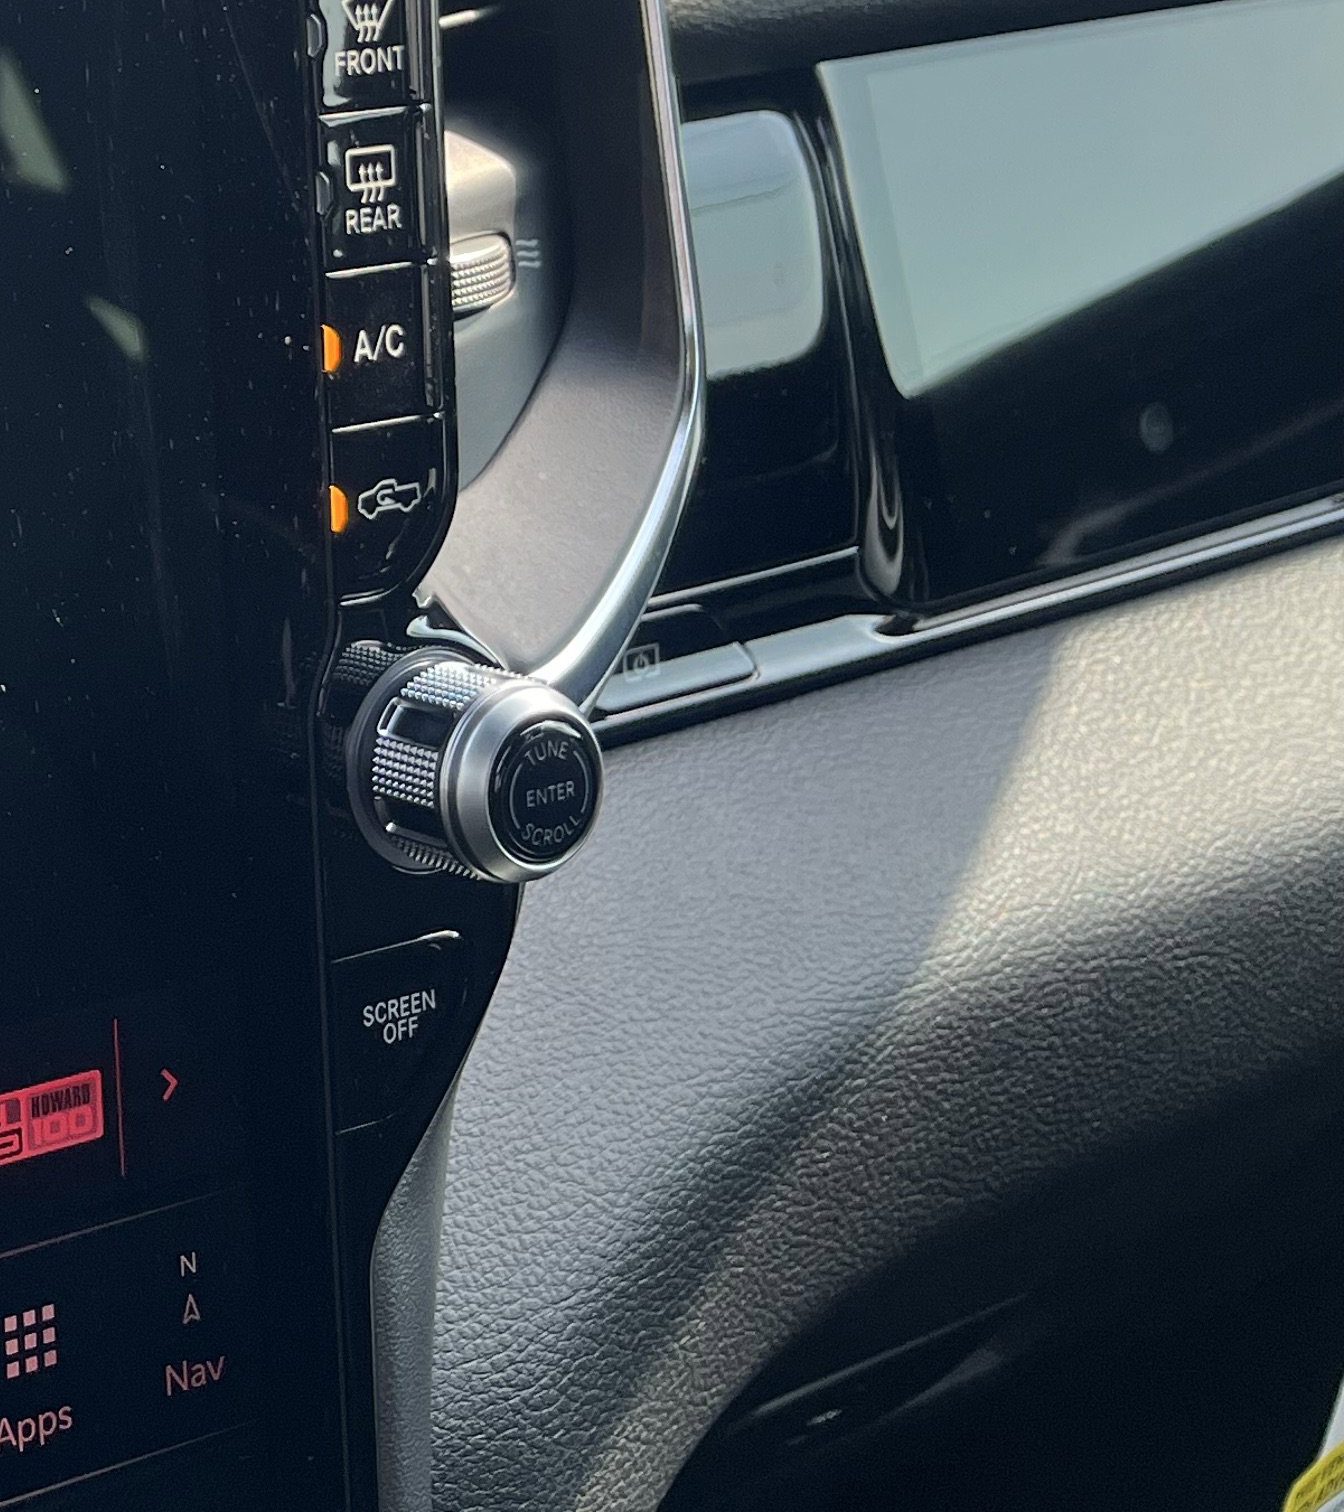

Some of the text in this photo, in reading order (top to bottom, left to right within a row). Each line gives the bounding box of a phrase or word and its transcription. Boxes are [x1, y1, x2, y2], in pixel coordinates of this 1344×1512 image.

[334, 44, 405, 77] FRONT
[345, 203, 402, 234] REAR
[353, 323, 406, 363] A/C
[524, 740, 569, 766] TUNE
[526, 780, 576, 808] ENTER
[521, 815, 581, 846] SCROLL
[362, 989, 437, 1028] SCREEN
[383, 1016, 420, 1044] OFF
[30, 1083, 92, 1119] HOWARD
[30, 1103, 94, 1147] 100
[179, 1252, 198, 1277] N
[164, 1354, 227, 1398] Nav
